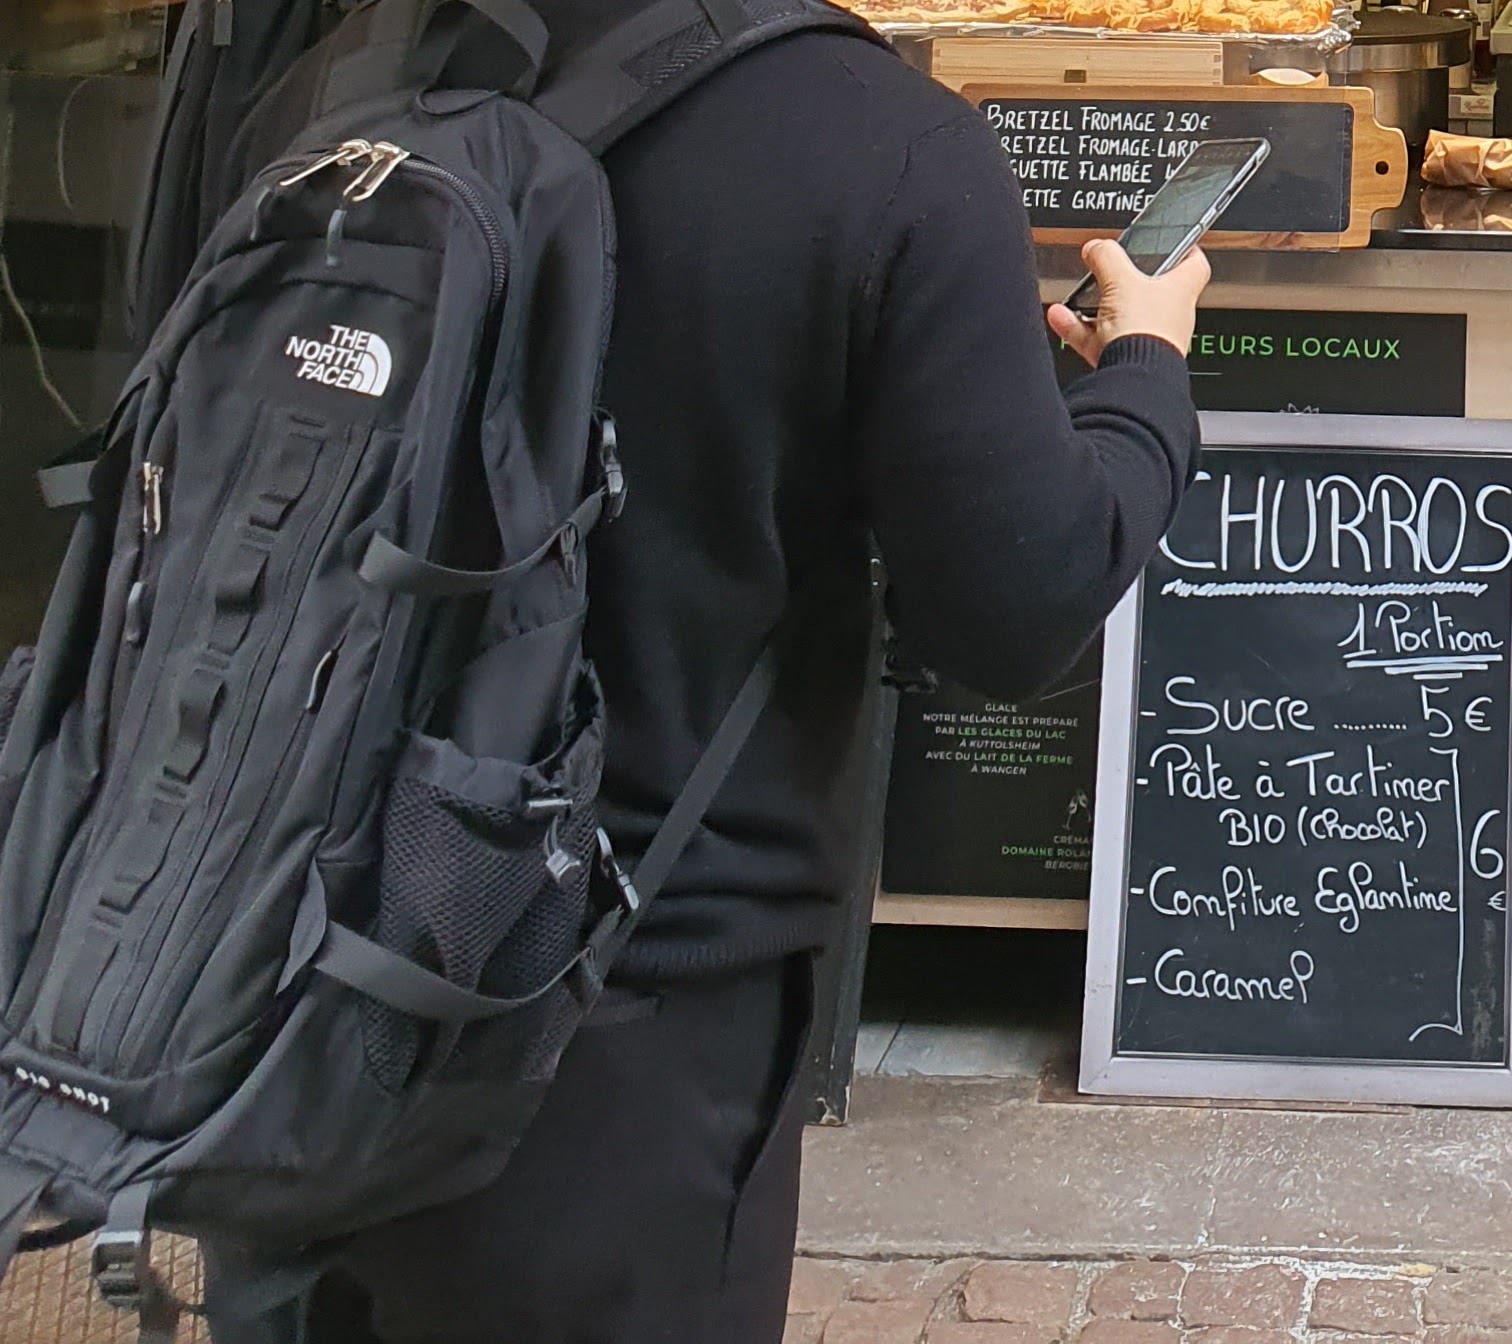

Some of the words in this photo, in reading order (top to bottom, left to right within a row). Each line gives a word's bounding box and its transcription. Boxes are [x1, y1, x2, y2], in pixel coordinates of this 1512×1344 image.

[987, 104, 1073, 130] BRETZEL
[1080, 107, 1156, 132] FROMAGE
[1079, 161, 1152, 183] FLAMBÉE
[330, 325, 371, 350] THE
[1286, 338, 1399, 359] LOCAUX
[285, 336, 363, 370] NORTH
[297, 362, 357, 388] FACE
[1339, 603, 1376, 658] 1
[1375, 600, 1504, 654] Portion
[923, 713, 956, 722] NOTRE
[961, 712, 1009, 724] MÉLANGE
[985, 704, 1018, 712] GLACE
[1165, 676, 1314, 735] Sucre
[935, 726, 955, 735] PAR
[958, 727, 977, 736] LES
[981, 728, 1022, 737] GLACES
[1026, 729, 1042, 738] DU
[1046, 730, 1066, 739] LAC
[926, 751, 952, 760] AVEC
[956, 752, 970, 760] DU
[974, 752, 997, 760] LAIT
[1150, 744, 1241, 800] Pâte
[1256, 761, 1284, 799] à
[1219, 808, 1285, 846] BIO
[1002, 846, 1053, 856] DOMAINE
[1470, 809, 1504, 880] 6
[1155, 949, 1313, 1003] Caramel
